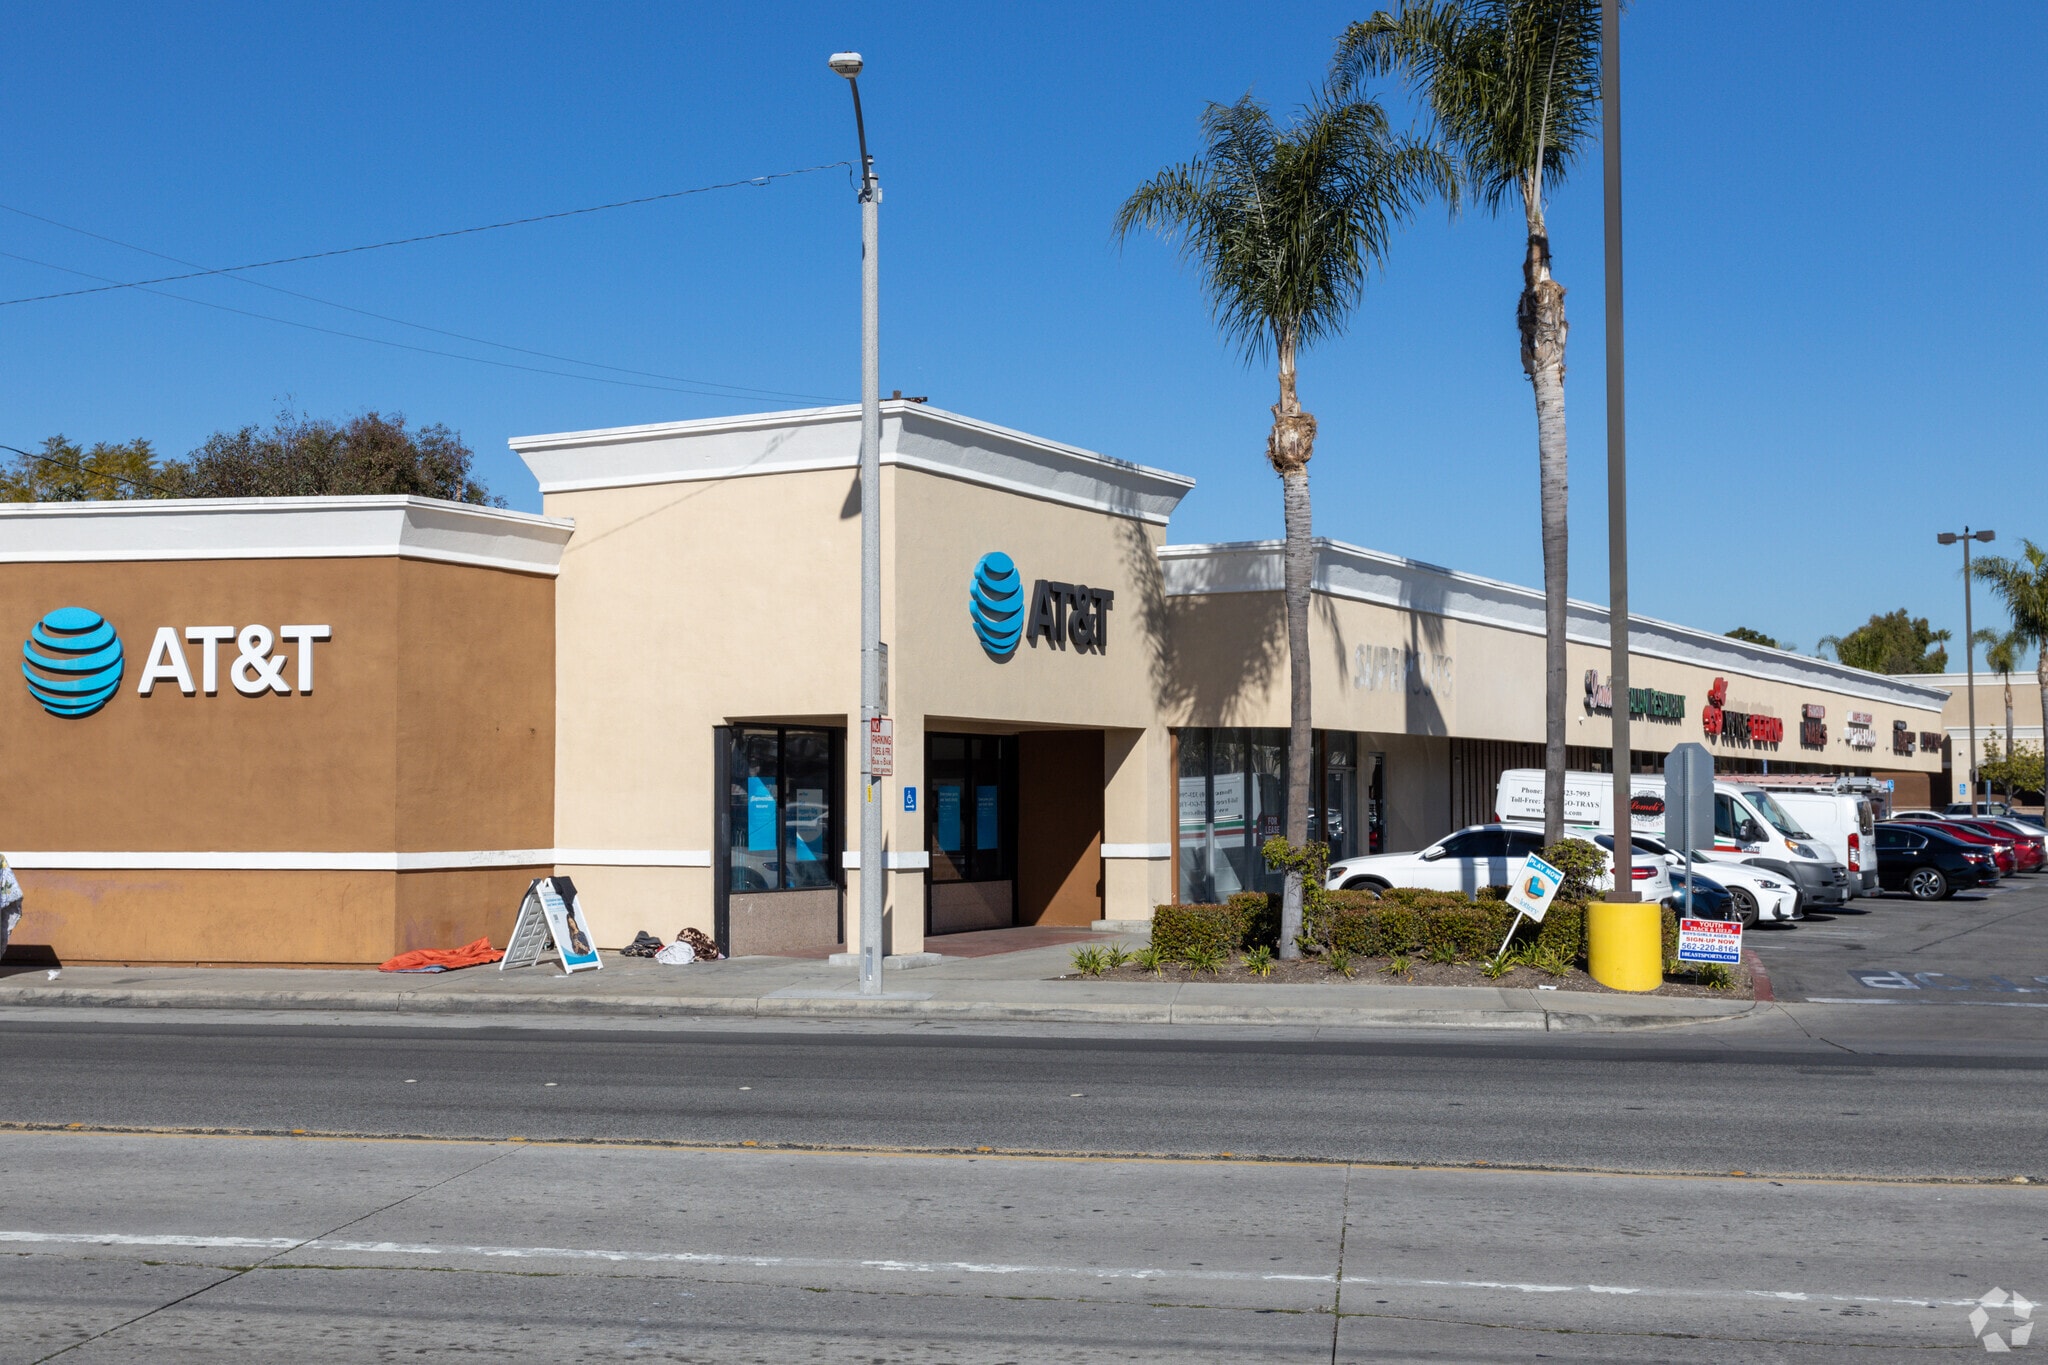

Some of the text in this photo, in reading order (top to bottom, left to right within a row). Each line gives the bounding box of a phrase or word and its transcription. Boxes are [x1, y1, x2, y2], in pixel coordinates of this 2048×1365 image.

[1026, 579, 1114, 647] AT&T
[137, 624, 332, 694] AT&T
[1645, 688, 1686, 718] RESTAURANT
[872, 720, 879, 731] NO
[1804, 724, 1828, 745] NAILS
[872, 735, 892, 745] PARKING
[1521, 787, 1543, 795] Phone:
[1511, 796, 1541, 805] Toll-Free:
[1268, 816, 1278, 826] FOR
[1265, 825, 1280, 834] LEASE
[1529, 857, 1562, 881] PLAY NOW
[1682, 943, 1738, 952] 562-220-8164
